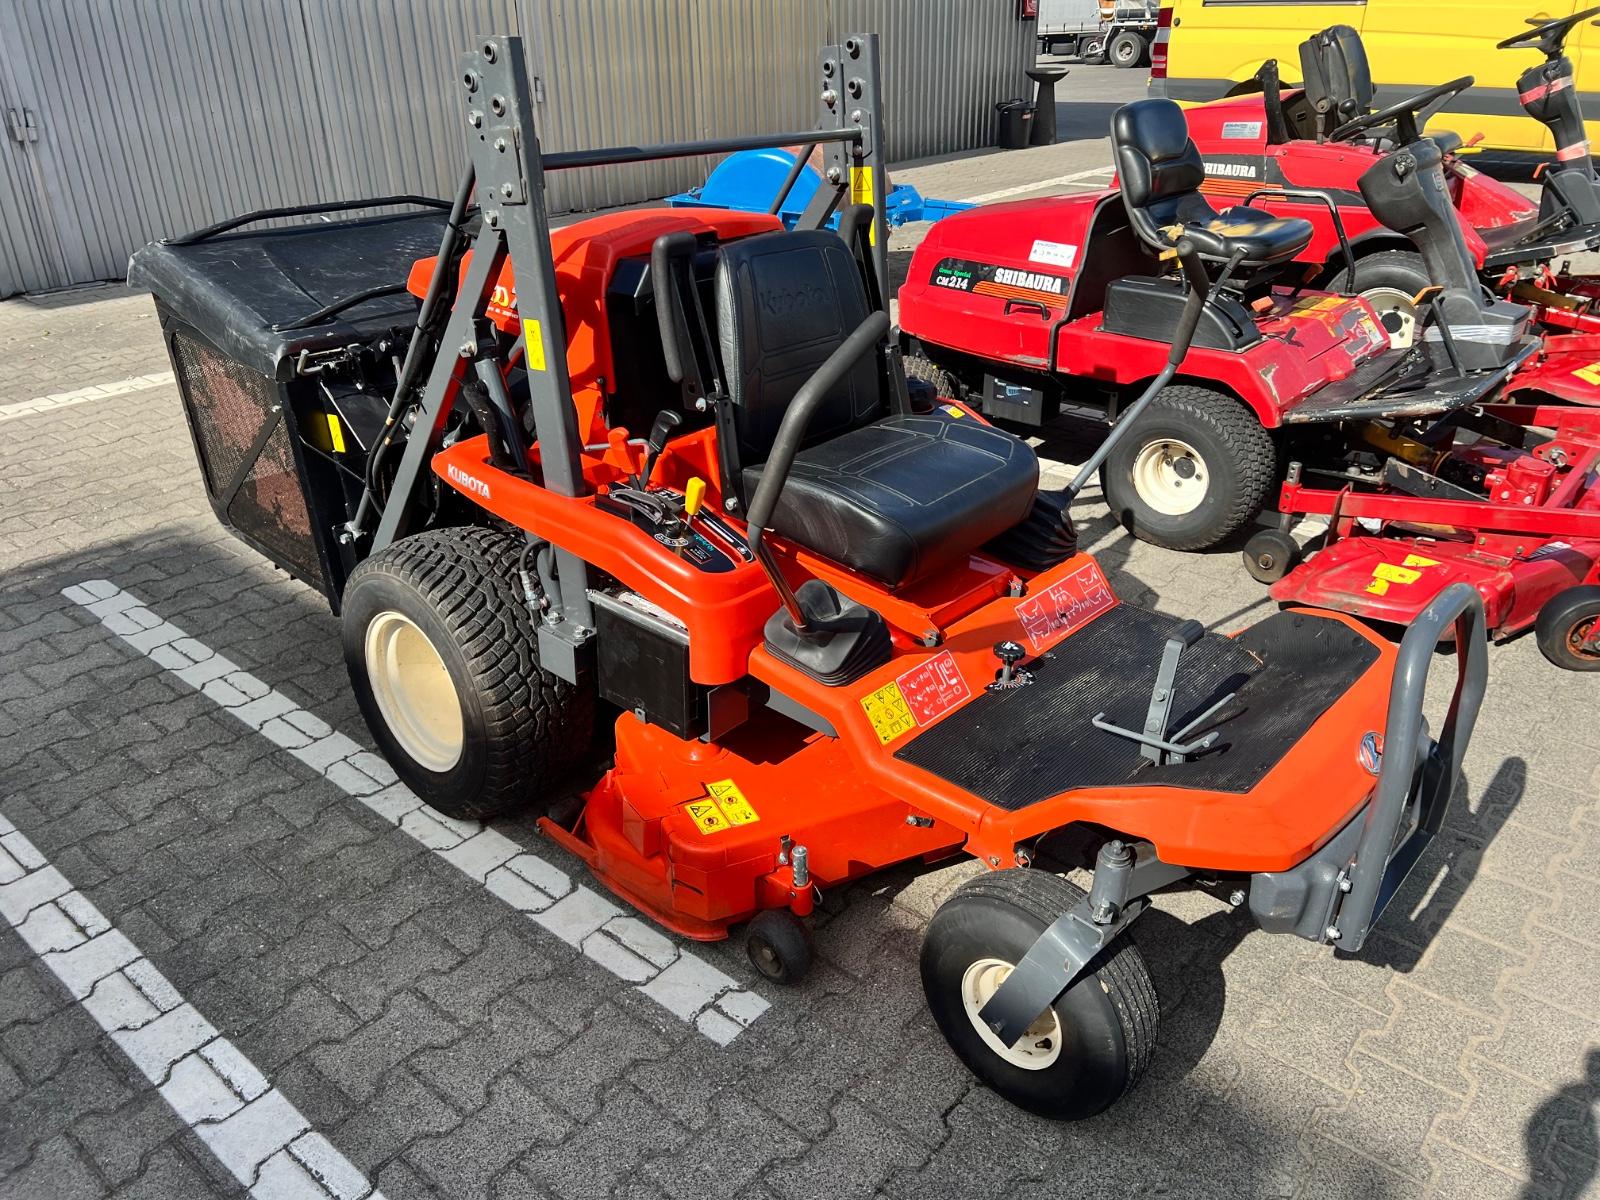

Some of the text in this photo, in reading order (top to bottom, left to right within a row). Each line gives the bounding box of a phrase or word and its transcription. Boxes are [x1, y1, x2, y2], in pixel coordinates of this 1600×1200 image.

[1203, 163, 1256, 178] HIBAURA
[994, 268, 1062, 294] SHIBAURA
[448, 463, 491, 500] KUBOTA
